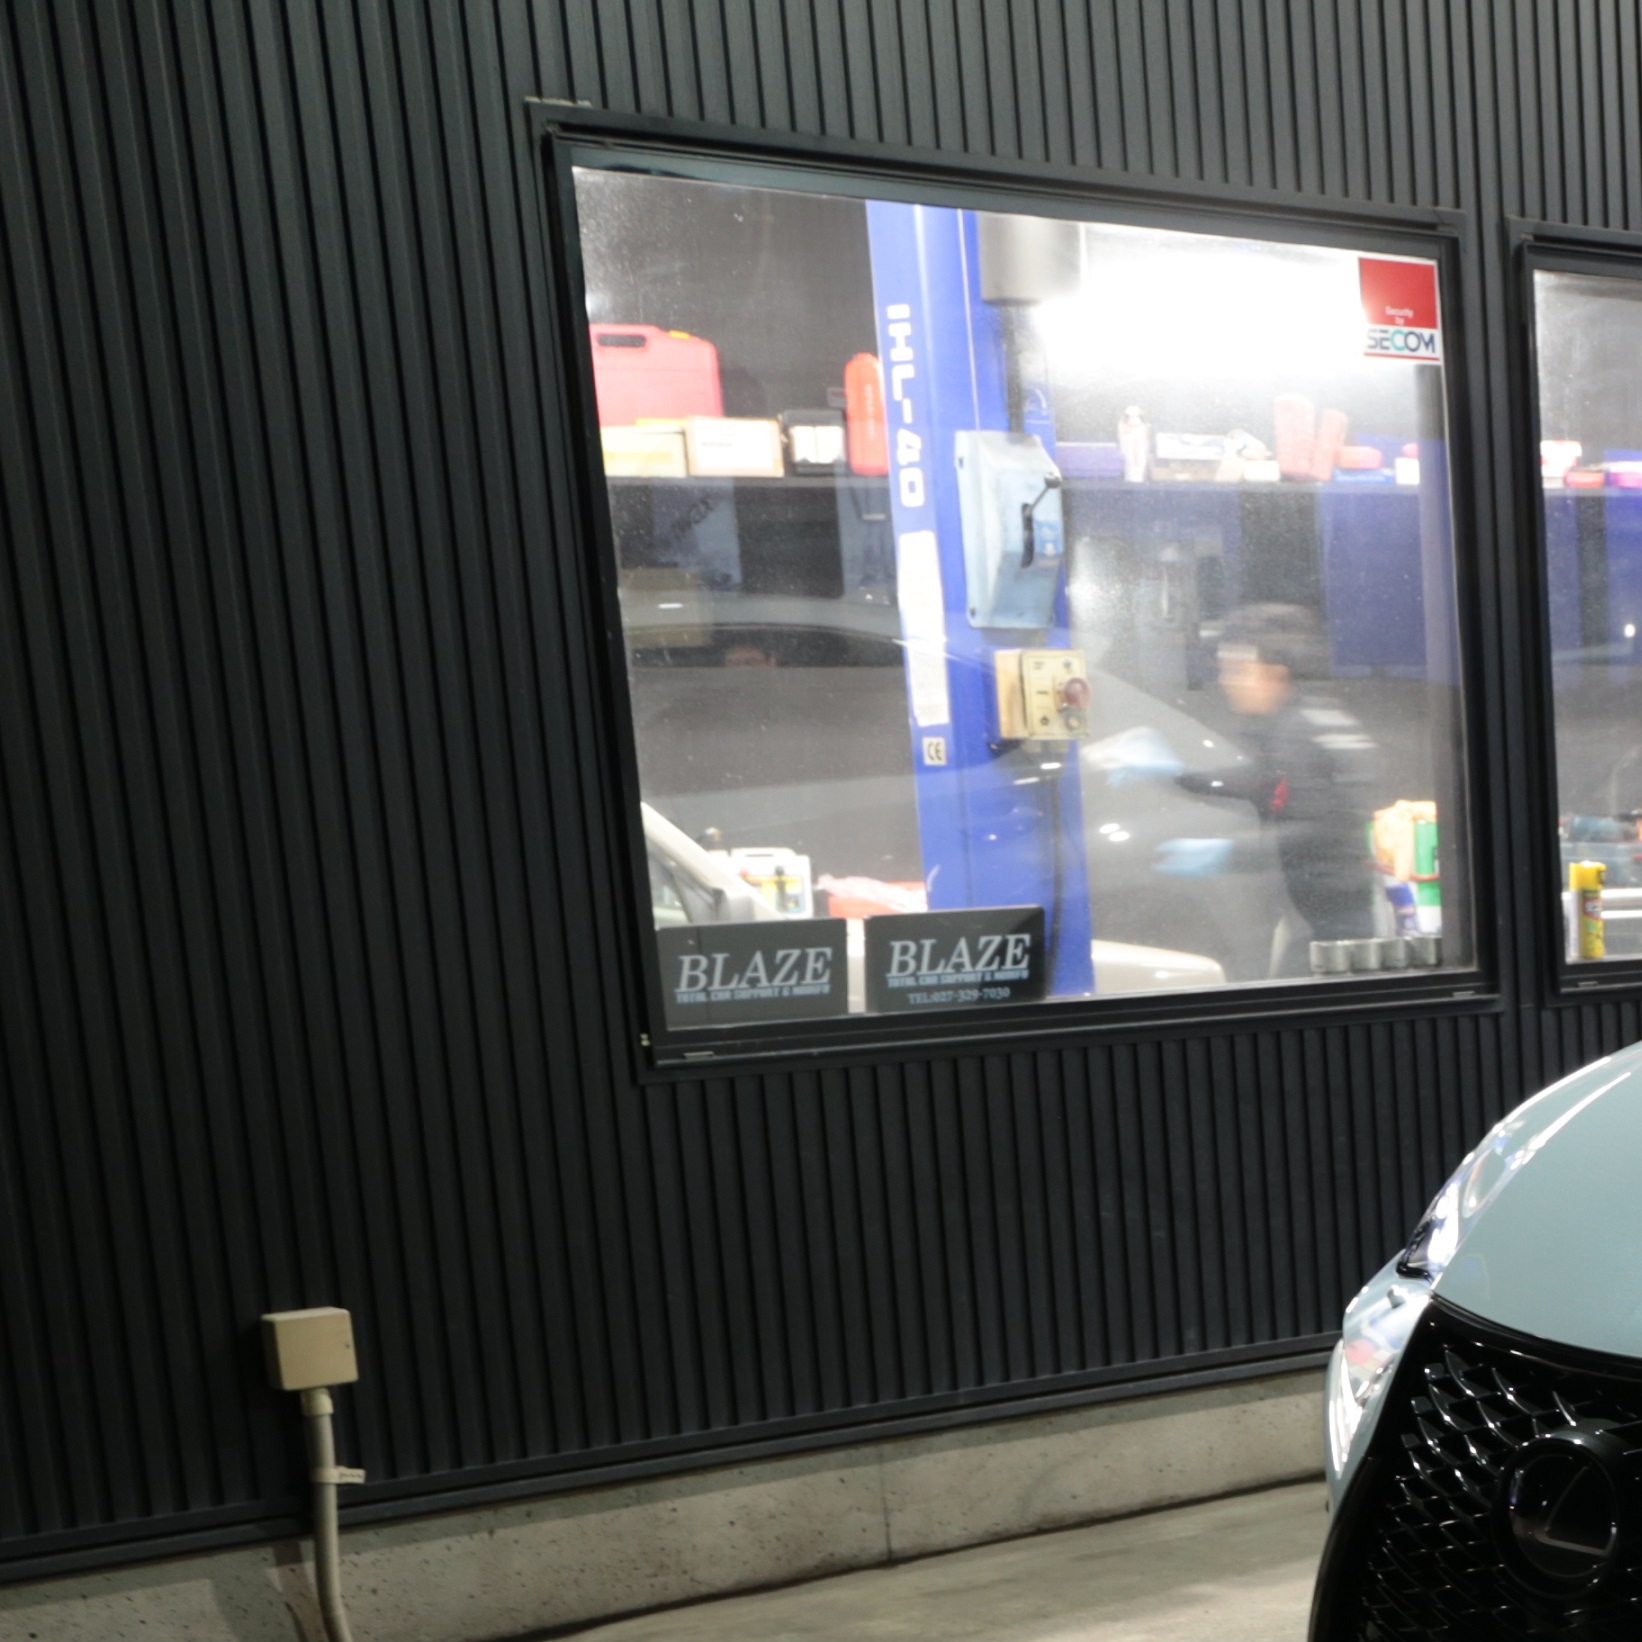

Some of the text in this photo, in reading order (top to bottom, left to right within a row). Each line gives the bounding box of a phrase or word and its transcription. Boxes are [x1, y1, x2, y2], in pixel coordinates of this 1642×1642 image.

[1384, 305, 1414, 318] Security
[1367, 329, 1436, 353] SECOM
[885, 933, 1031, 978] BLAZE
[674, 946, 834, 993] BLAZE
[887, 976, 917, 988] TOTAL
[940, 972, 983, 984] SUPPORT
[675, 991, 708, 1004] TOTAL
[733, 986, 780, 1000] SUPPORT
